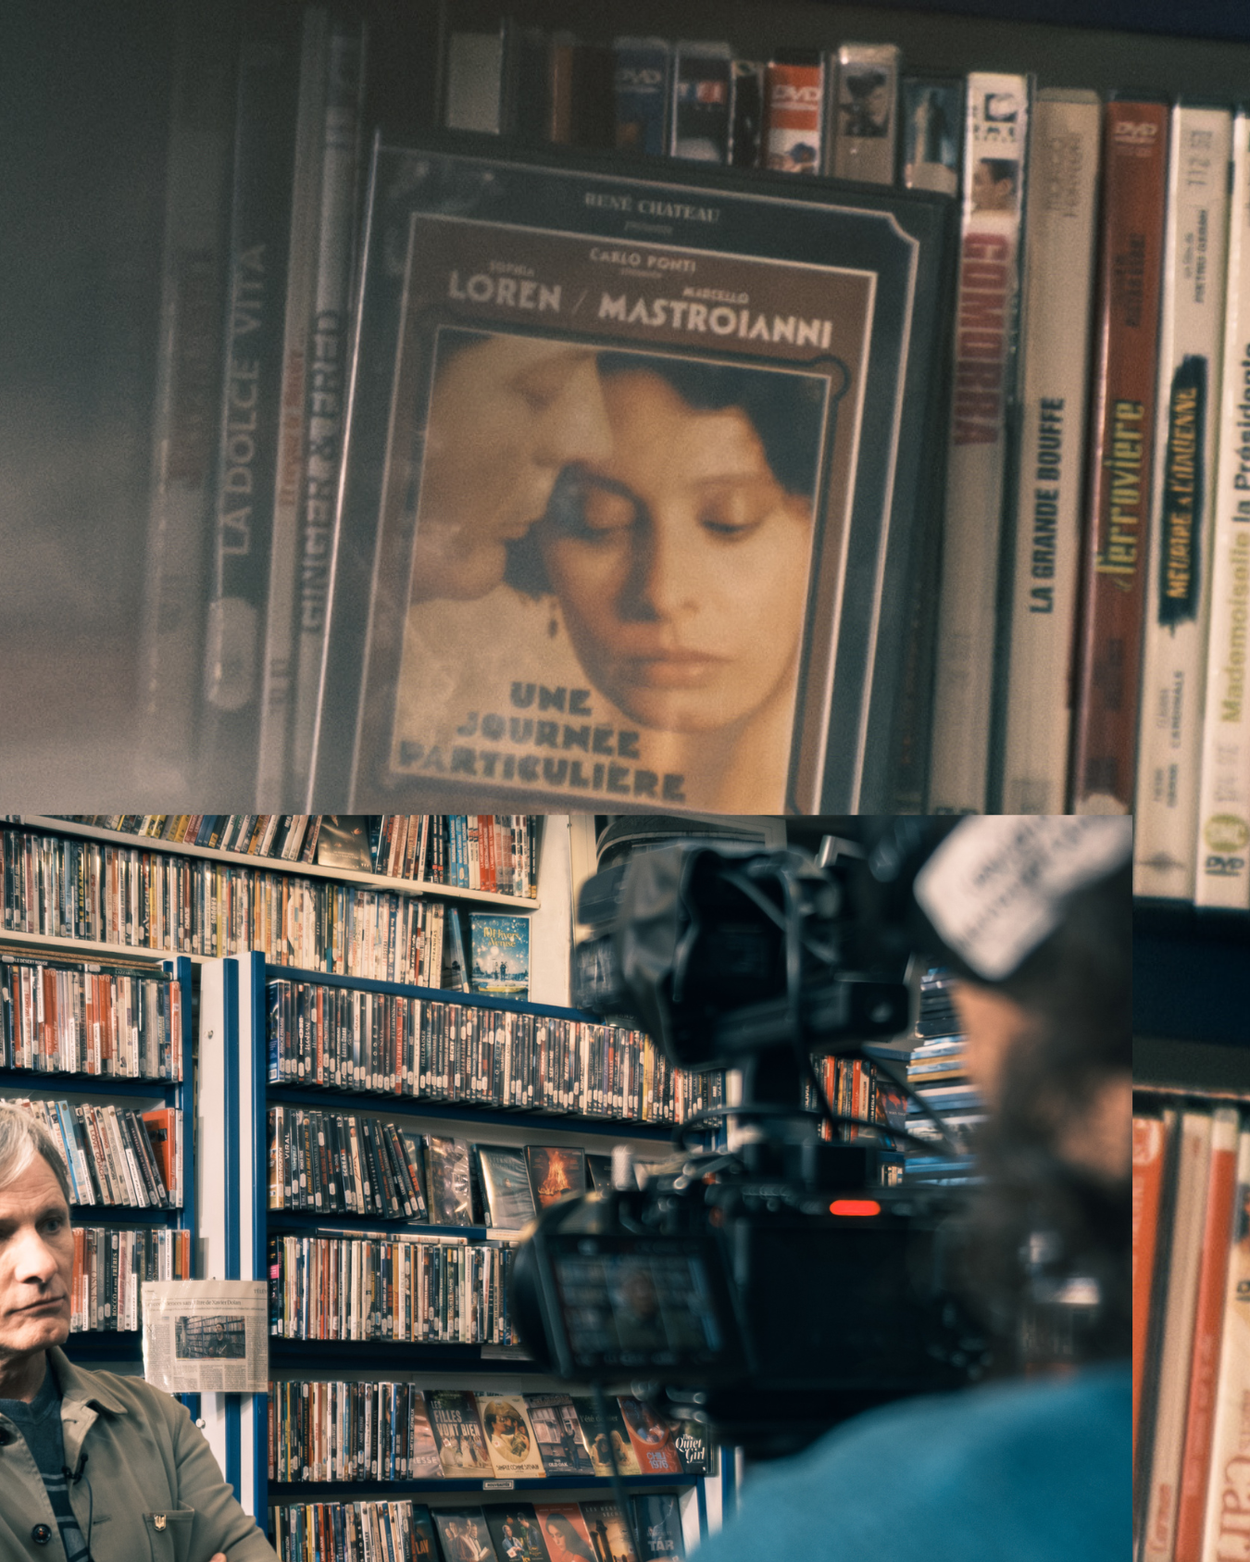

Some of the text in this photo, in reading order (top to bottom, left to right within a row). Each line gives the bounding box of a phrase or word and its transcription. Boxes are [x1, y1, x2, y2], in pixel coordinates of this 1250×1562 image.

[638, 197, 720, 223] CHATEAU
[590, 248, 696, 273] CARLO PONTI
[450, 270, 833, 349] LOREN MASTROIANNI
[954, 232, 1009, 445] GOMORRA
[311, 308, 340, 420] FRED
[222, 244, 267, 554] LA DOLCE VITA
[1093, 399, 1146, 574] Ferroviere
[1030, 397, 1065, 614] LA GRANDE BOUFFE
[1230, 497, 1250, 523] la
[301, 477, 333, 635] GINGER
[1165, 511, 1193, 599] MEURTRE
[1219, 530, 1250, 724] Mademoiselle
[511, 681, 592, 717] UNE
[1206, 857, 1245, 875] DVD
[431, 1401, 441, 1409] LES
[433, 1410, 462, 1422] FILLES
[436, 1424, 481, 1436] VONT BIEN
[675, 1436, 701, 1449] Quiet
[649, 1460, 669, 1469] 1976
[685, 1447, 705, 1463] Girl
[648, 1536, 674, 1551] TÁR
